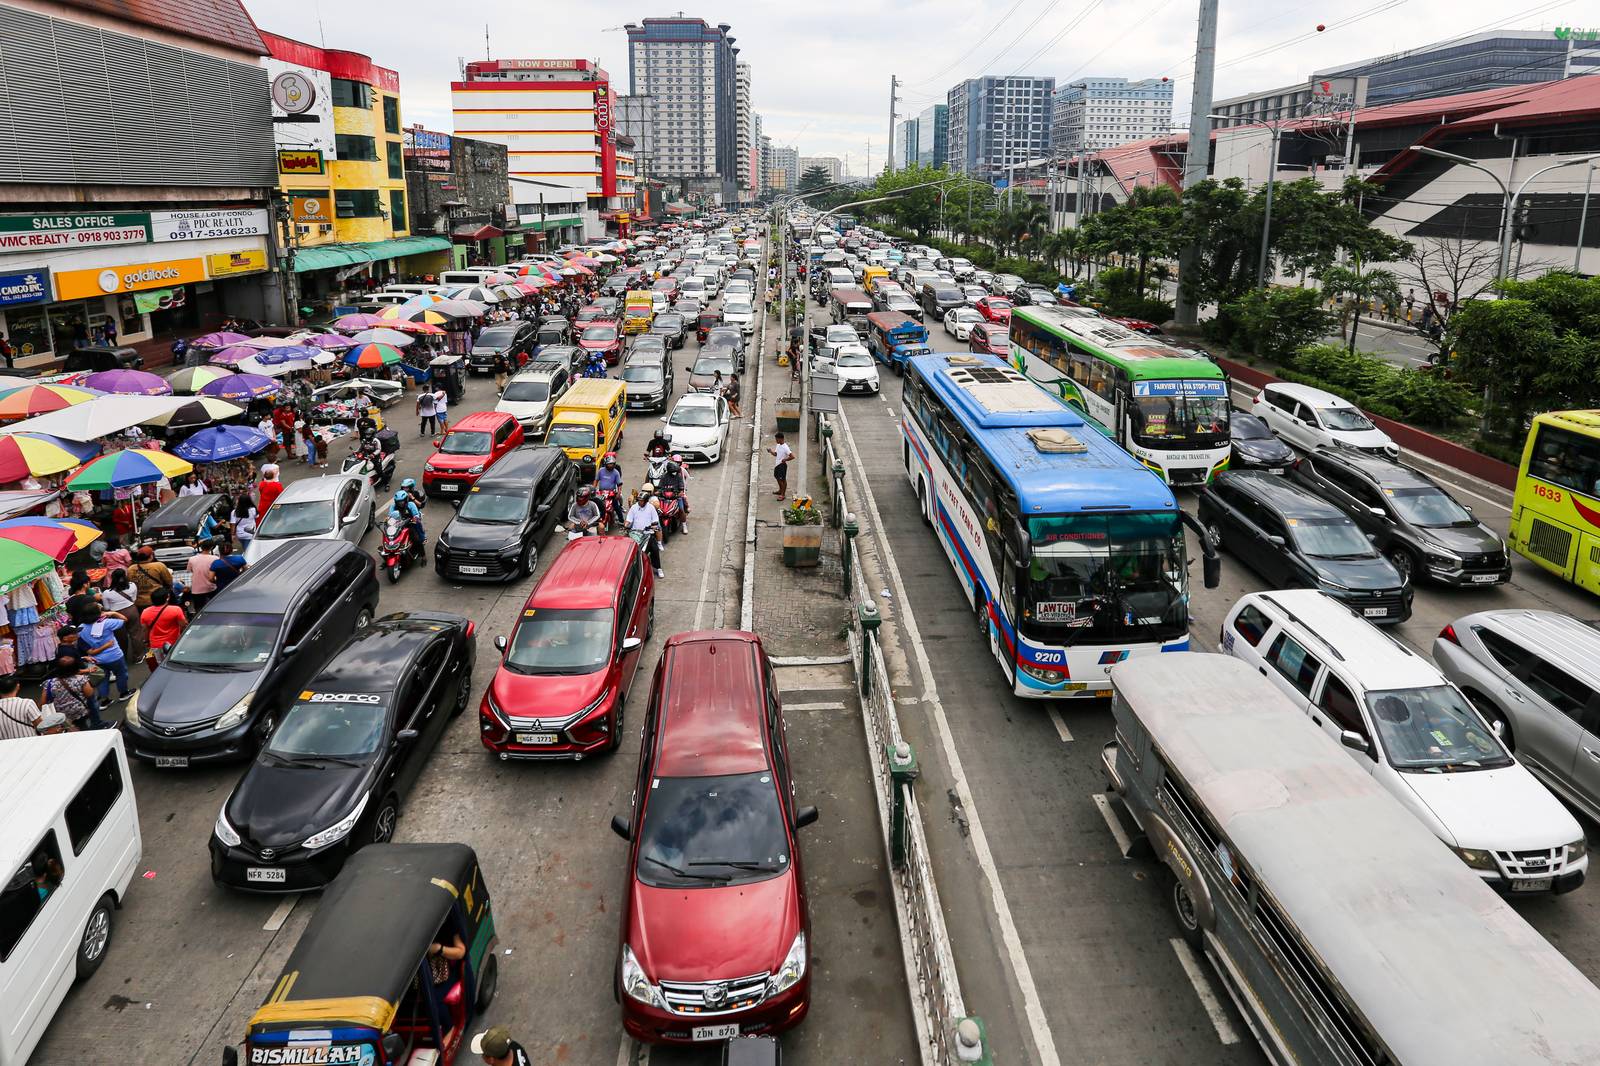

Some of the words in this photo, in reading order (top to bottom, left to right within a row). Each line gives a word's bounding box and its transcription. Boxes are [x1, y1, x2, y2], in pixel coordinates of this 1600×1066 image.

[33, 217, 72, 229] SALES
[75, 216, 115, 227] OFFICE
[194, 219, 212, 229] PDC
[213, 217, 244, 228] REALTY
[0, 235, 27, 247] VMC
[29, 233, 70, 246] REALTY
[77, 231, 102, 243] 0918
[103, 230, 121, 241] 903
[123, 229, 145, 240] 3779
[170, 226, 258, 239] 0917-5346233
[124, 267, 180, 290] goldilocks
[1, 284, 28, 295] CARGO
[29, 283, 45, 292] INC.
[1135, 384, 1147, 395] 7
[1533, 484, 1562, 503] 1633
[1038, 603, 1074, 615] LAWTON
[1035, 652, 1061, 663] 9210
[248, 871, 262, 879] NFR
[266, 871, 284, 879] 5284
[696, 1030, 713, 1039] ZDN
[719, 1027, 736, 1036] 870
[251, 1045, 361, 1065] BISMILLAH
